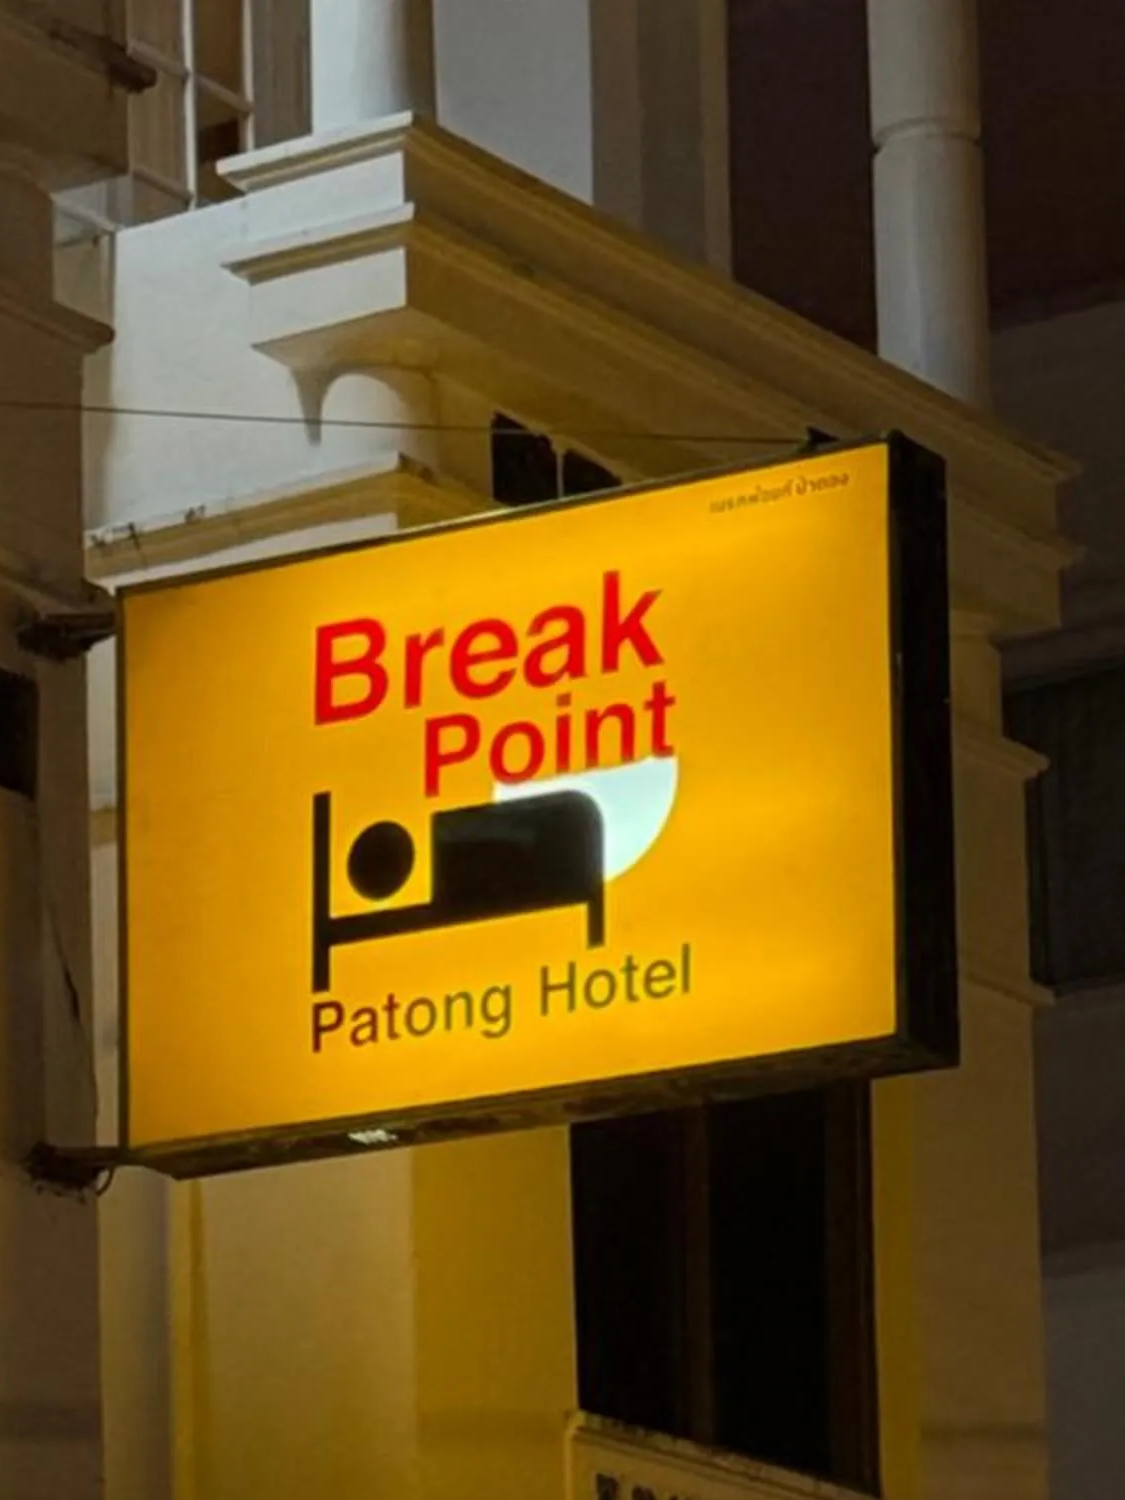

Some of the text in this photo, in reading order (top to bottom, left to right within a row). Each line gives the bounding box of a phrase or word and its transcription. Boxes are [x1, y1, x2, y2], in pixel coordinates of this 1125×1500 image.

[315, 570, 665, 727] Break
[424, 681, 675, 798] Point
[312, 943, 690, 1053] Patong Hotel
